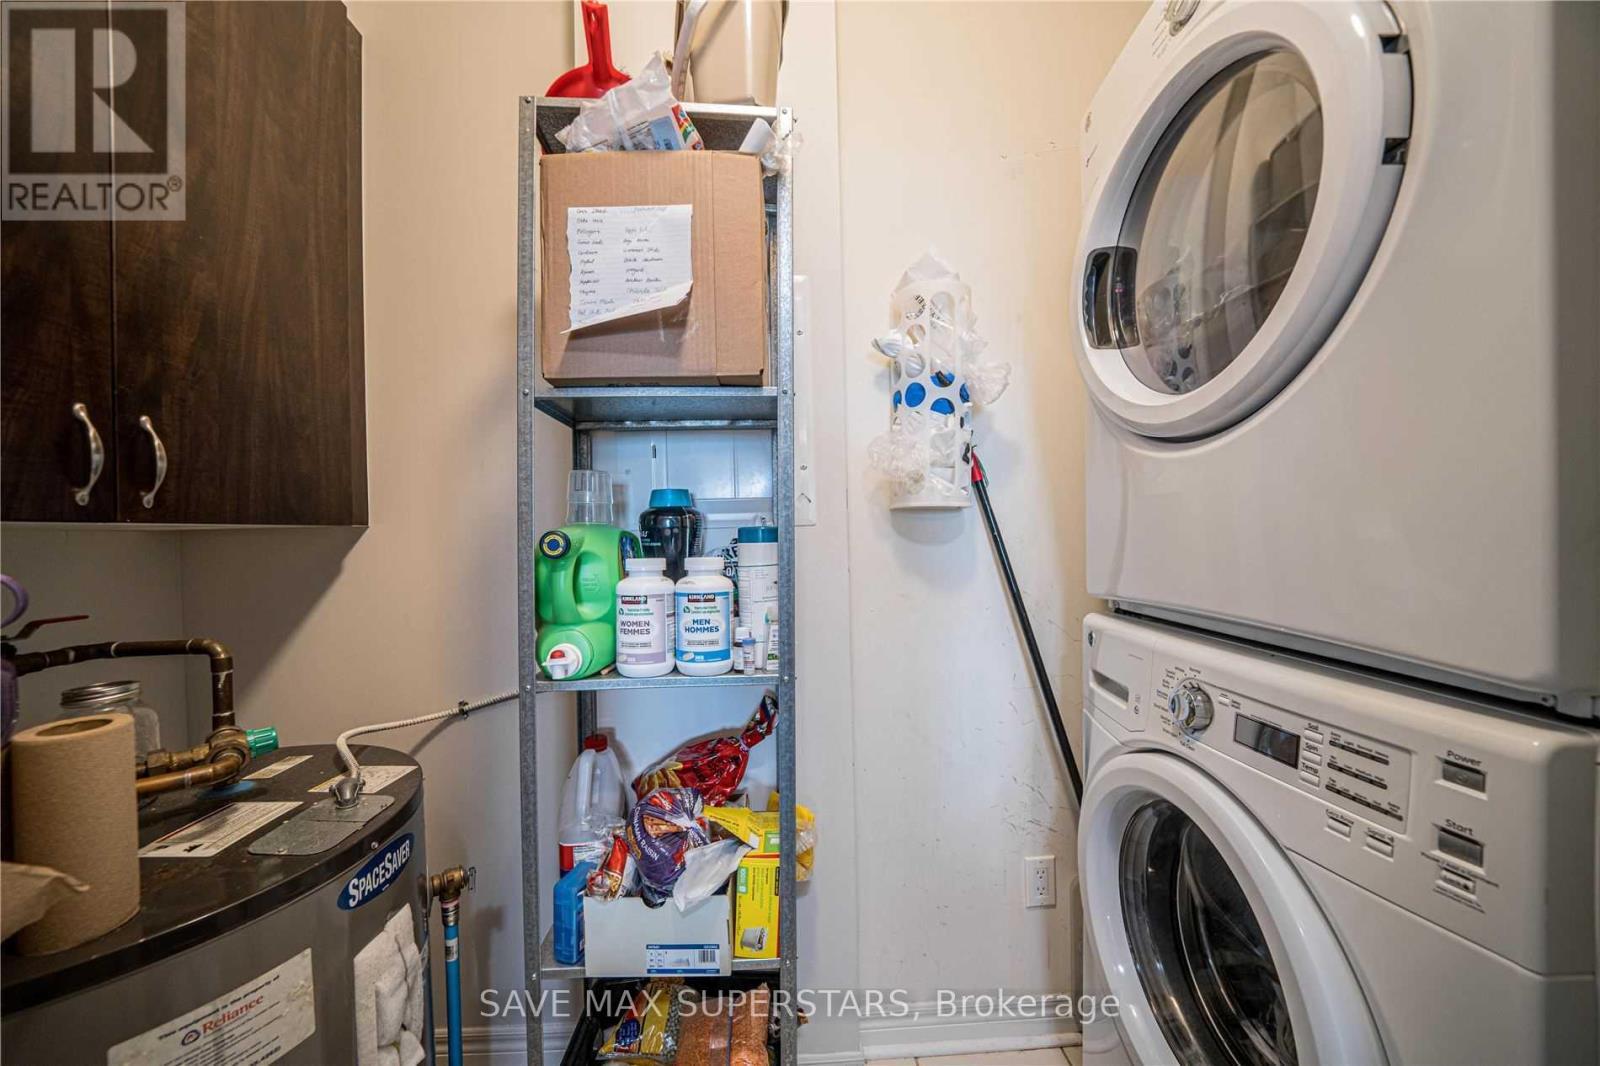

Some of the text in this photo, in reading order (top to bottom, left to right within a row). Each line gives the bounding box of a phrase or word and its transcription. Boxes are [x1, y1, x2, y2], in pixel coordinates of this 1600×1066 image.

[620, 620, 650, 628] WOMEN
[684, 626, 720, 634] HOMMES
[1447, 750, 1482, 767] Power
[1301, 762, 1319, 774] Temp
[1446, 819, 1473, 836] Start
[202, 995, 264, 1035] Reliance
